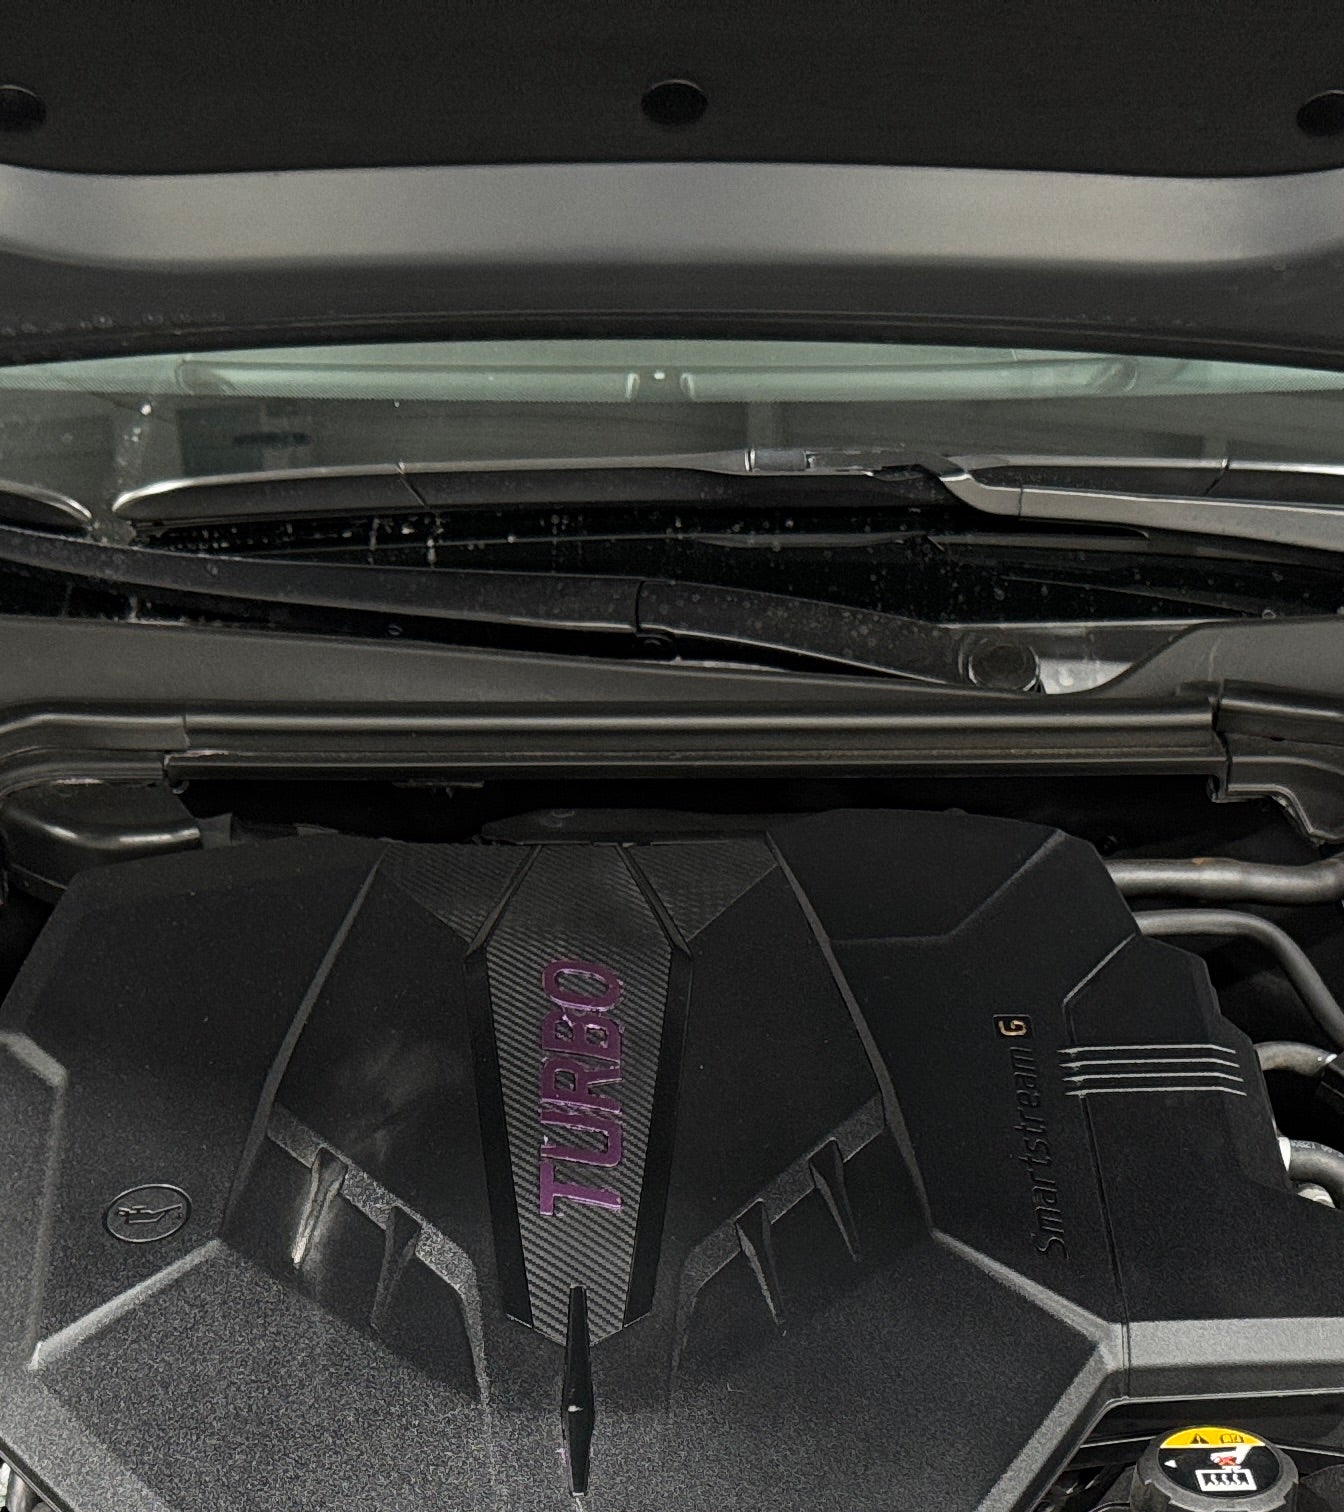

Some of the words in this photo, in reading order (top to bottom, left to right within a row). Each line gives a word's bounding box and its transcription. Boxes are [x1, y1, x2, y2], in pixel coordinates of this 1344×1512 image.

[539, 958, 624, 1216] TURBO
[998, 1019, 1028, 1036] G
[1008, 1046, 1072, 1262] Smartstream
